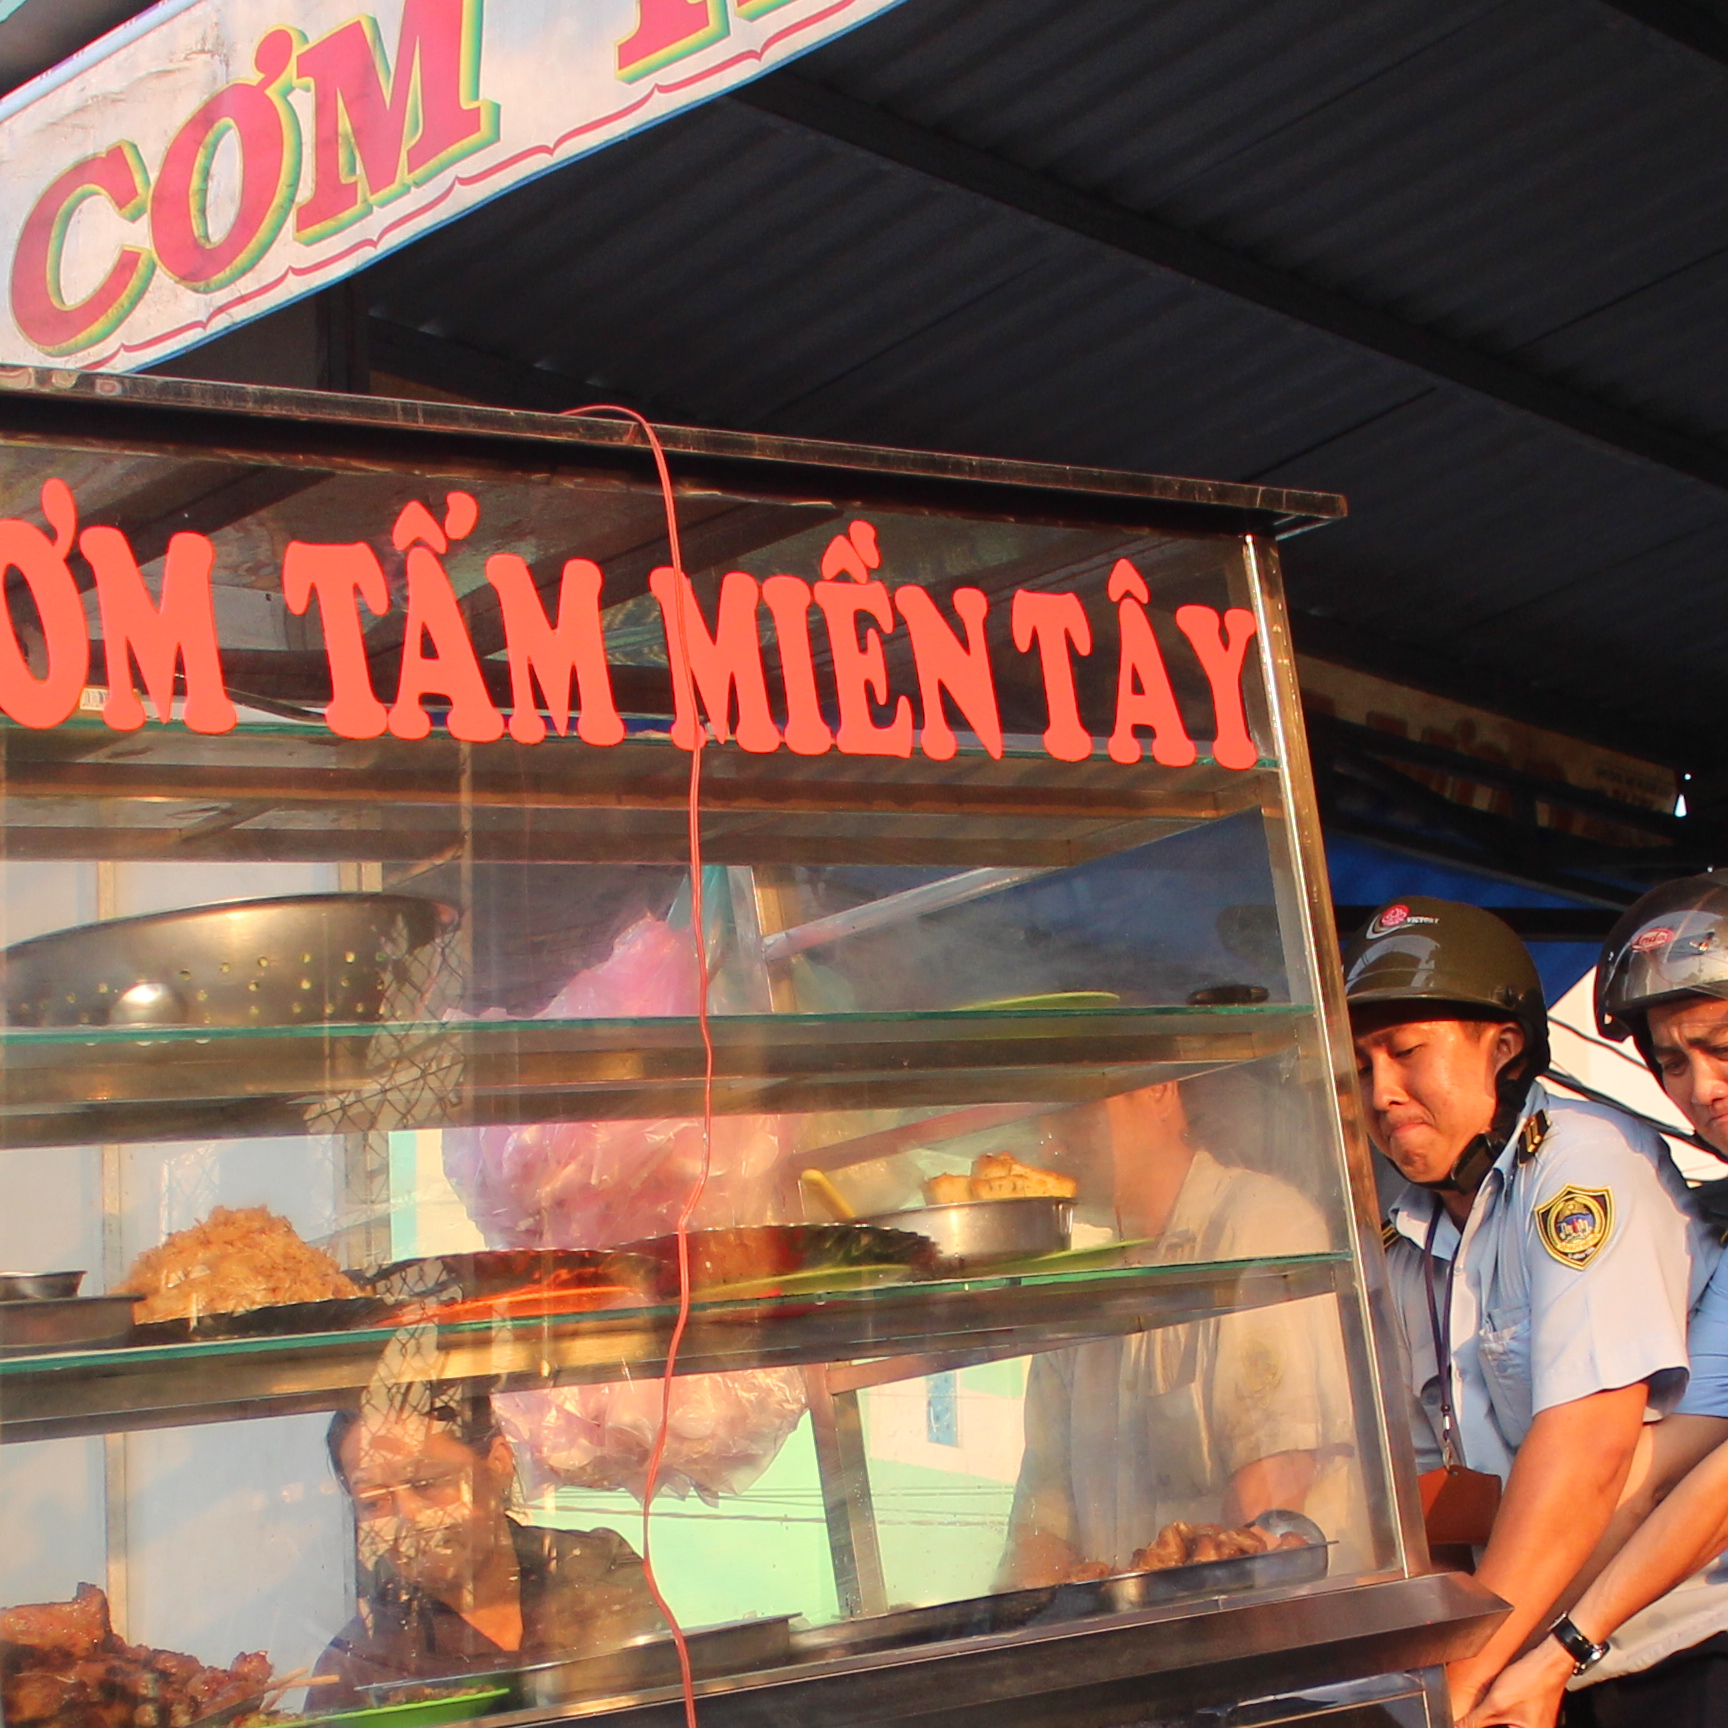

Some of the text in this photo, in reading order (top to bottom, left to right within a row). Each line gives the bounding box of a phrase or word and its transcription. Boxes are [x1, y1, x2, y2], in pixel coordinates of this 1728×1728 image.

[9, 0, 502, 358] CƠM
[282, 491, 627, 746] TẤM
[649, 520, 1005, 761] MIỀN
[1011, 558, 1259, 769] TÂY
